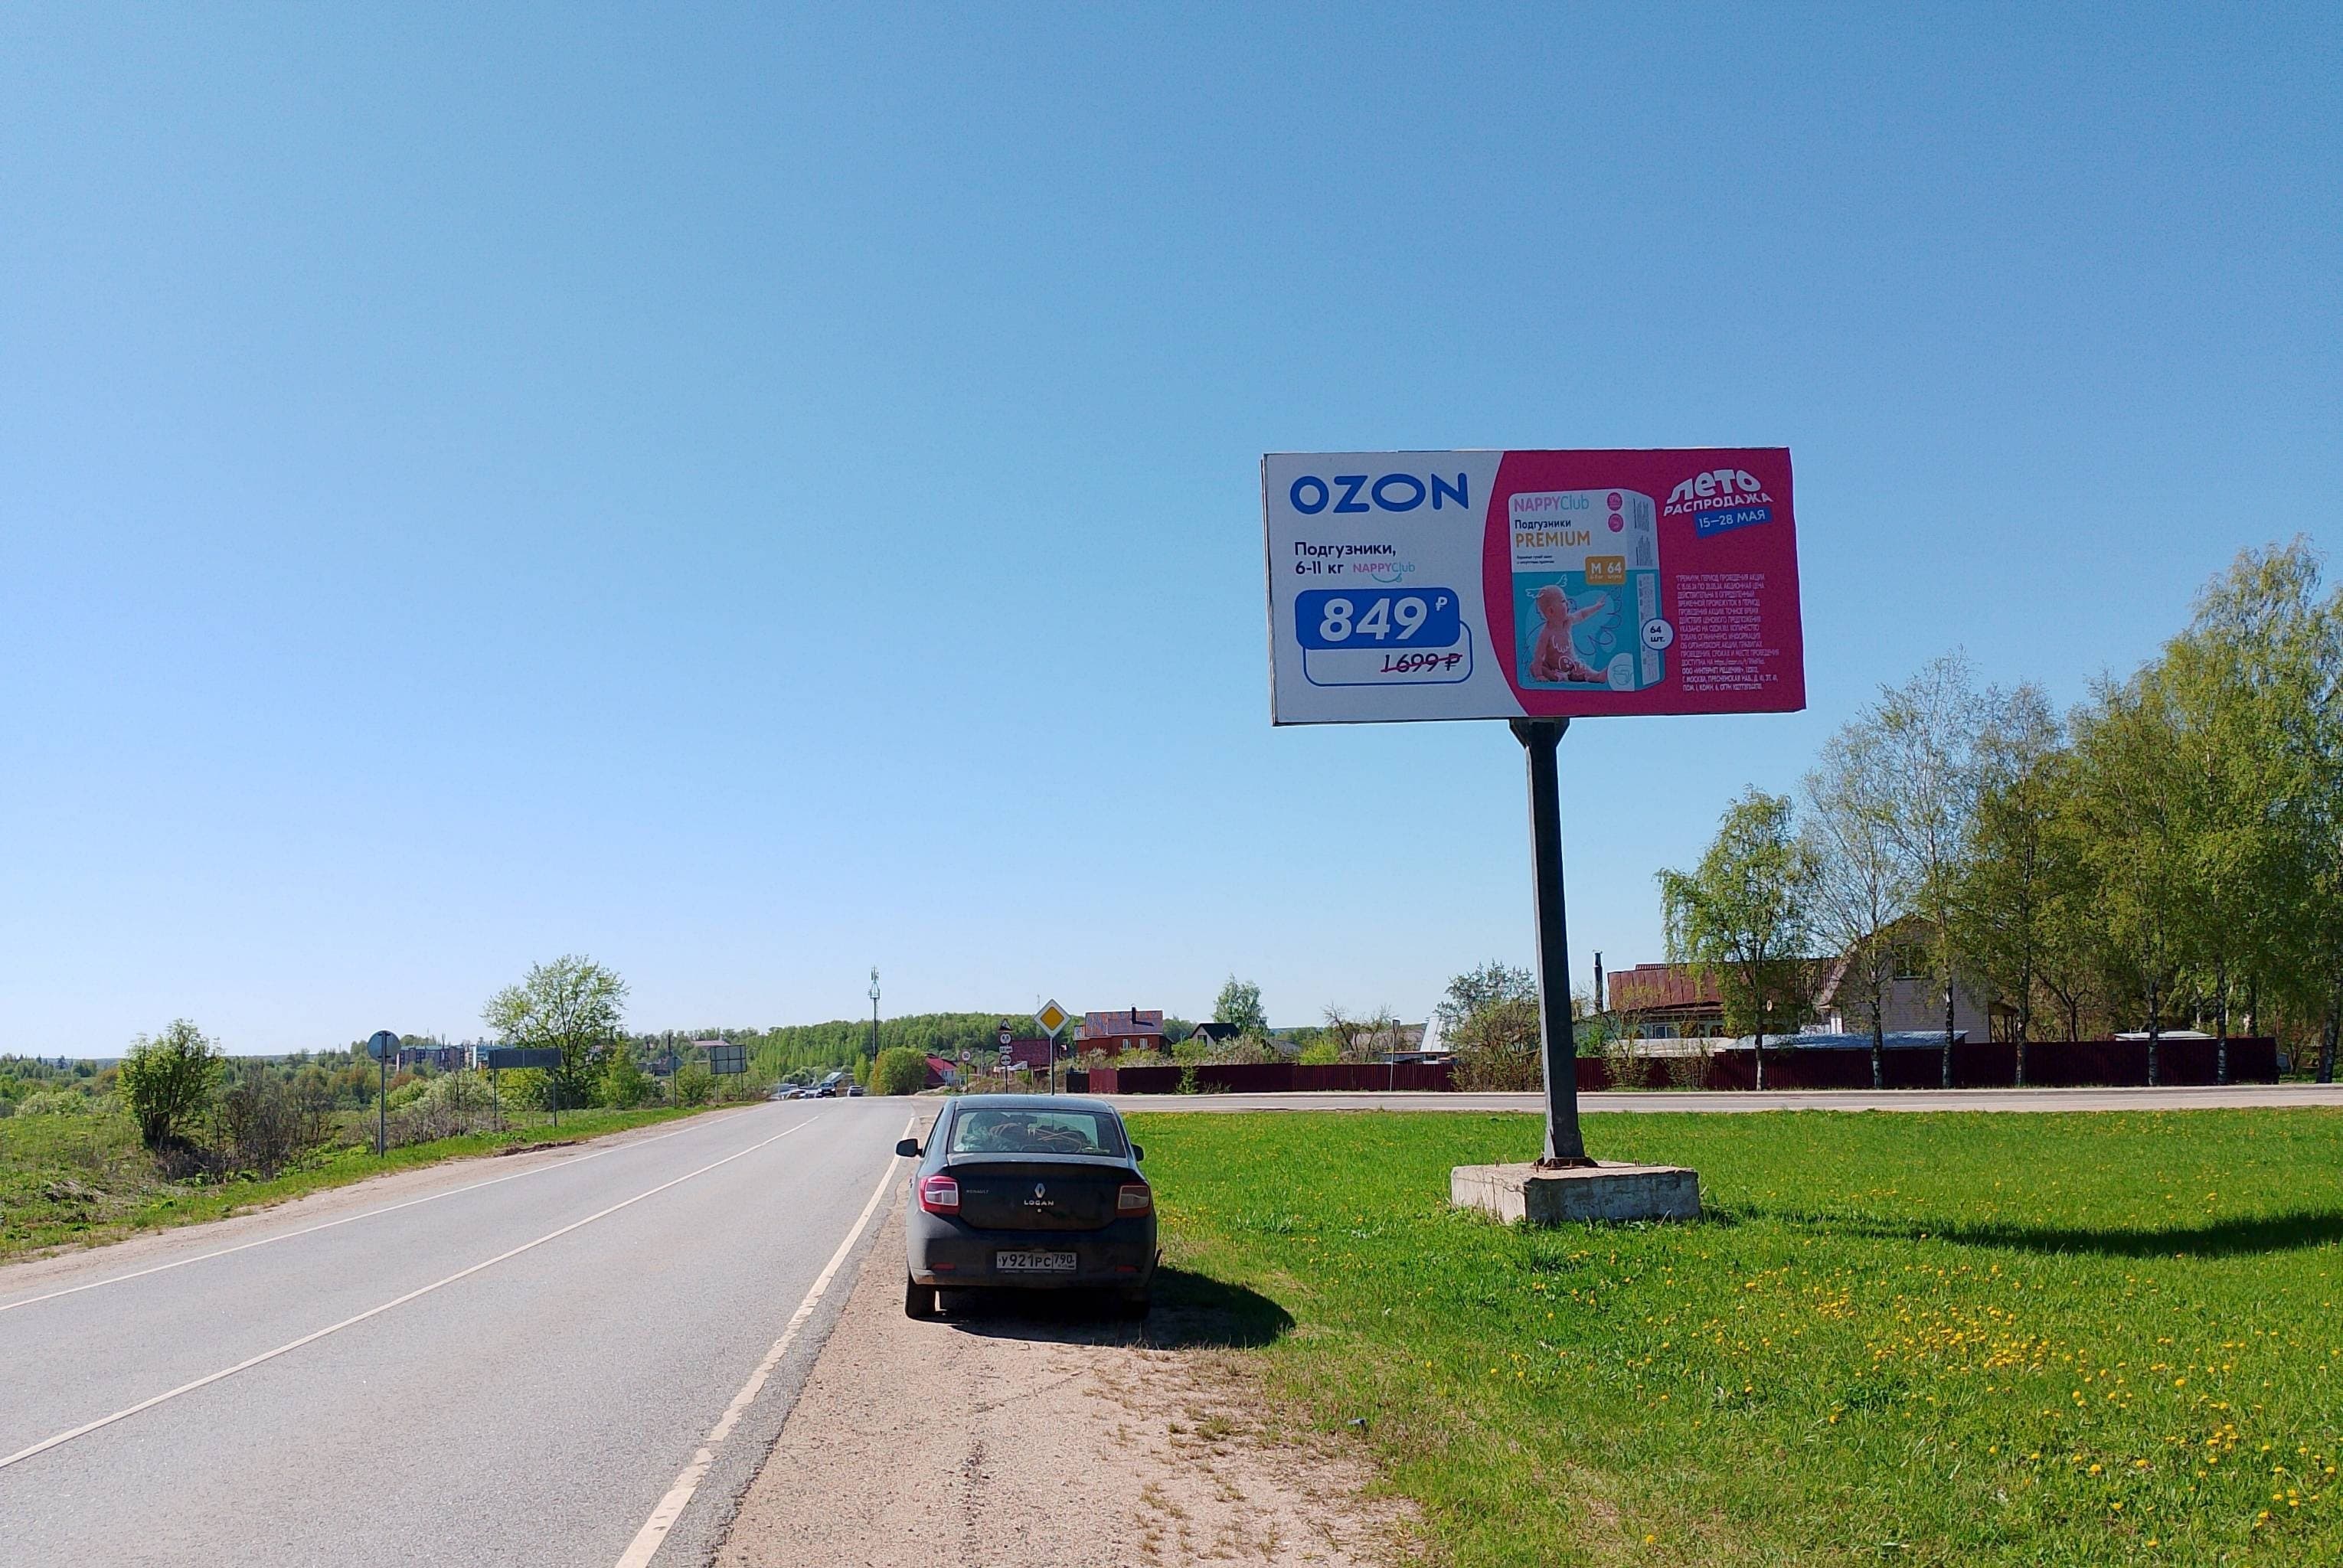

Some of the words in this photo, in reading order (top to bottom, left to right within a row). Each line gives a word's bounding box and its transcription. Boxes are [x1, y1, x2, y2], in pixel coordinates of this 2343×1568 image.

[1290, 472, 1469, 514] OZON
[1514, 495, 1589, 512] NAPPYClub
[1663, 492, 1774, 517] РАСПРОДАЖА
[1737, 510, 1766, 523] МАЯ
[1515, 519, 1571, 531] Подгузники
[1516, 531, 1590, 547] PREMIUM
[1295, 542, 1397, 558] Подгузники,
[1296, 561, 1322, 574] 6-11
[1328, 564, 1344, 574] кг
[1353, 562, 1415, 573] NAPPYClub
[1607, 562, 1622, 574] 64
[1319, 596, 1427, 642] 849
[1650, 626, 1662, 634] 64
[1054, 1254, 1072, 1263] 790
